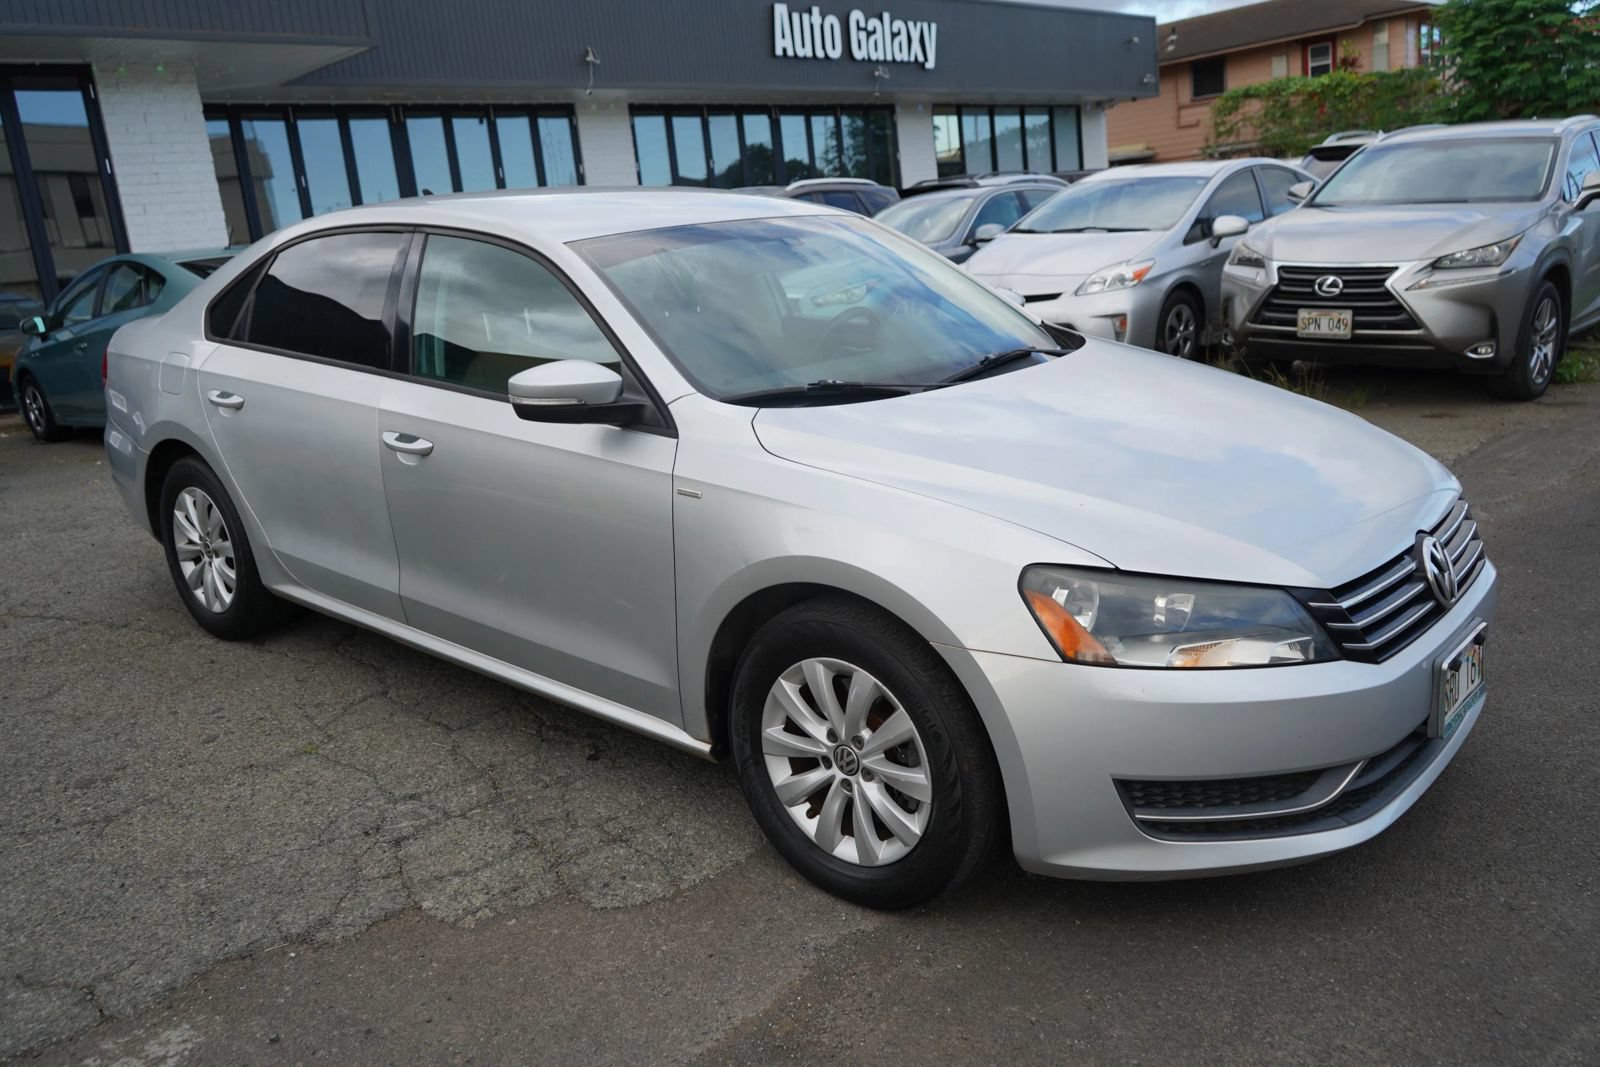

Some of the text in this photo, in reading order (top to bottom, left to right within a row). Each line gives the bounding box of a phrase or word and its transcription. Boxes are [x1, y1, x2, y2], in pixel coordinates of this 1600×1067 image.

[773, 3, 937, 69] Auto Galaxy
[1301, 316, 1348, 331] SPN 049
